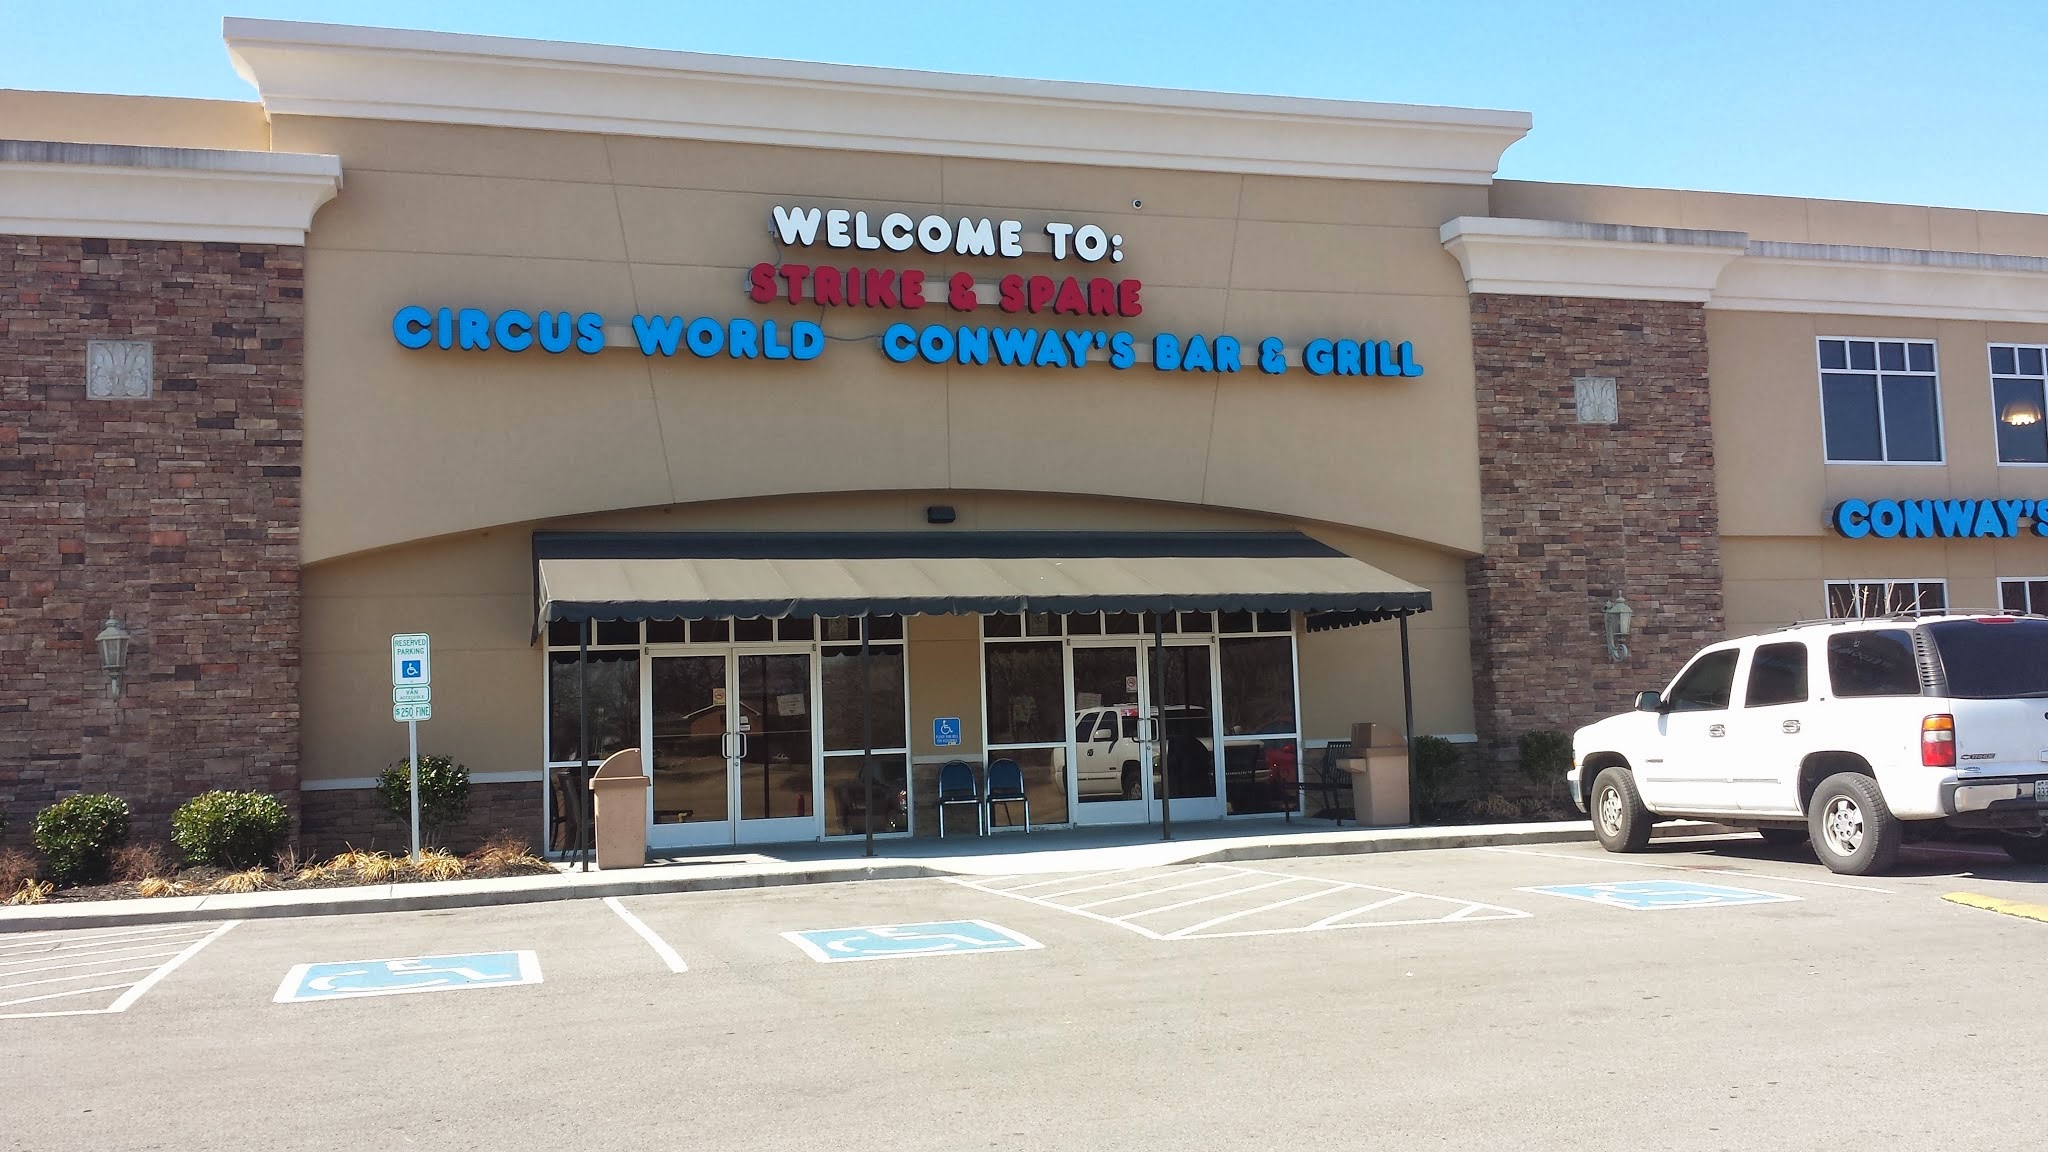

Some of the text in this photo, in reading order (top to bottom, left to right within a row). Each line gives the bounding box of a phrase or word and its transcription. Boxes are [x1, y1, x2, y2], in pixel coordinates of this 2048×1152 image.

[772, 205, 1124, 263] WELCOME TO:
[750, 262, 1144, 318] STRIKE & SPARE
[392, 304, 826, 361] CIRCUS WORLD
[882, 323, 1425, 377] CONWAY'S BAR & GRILL
[416, 706, 430, 716] FINE
